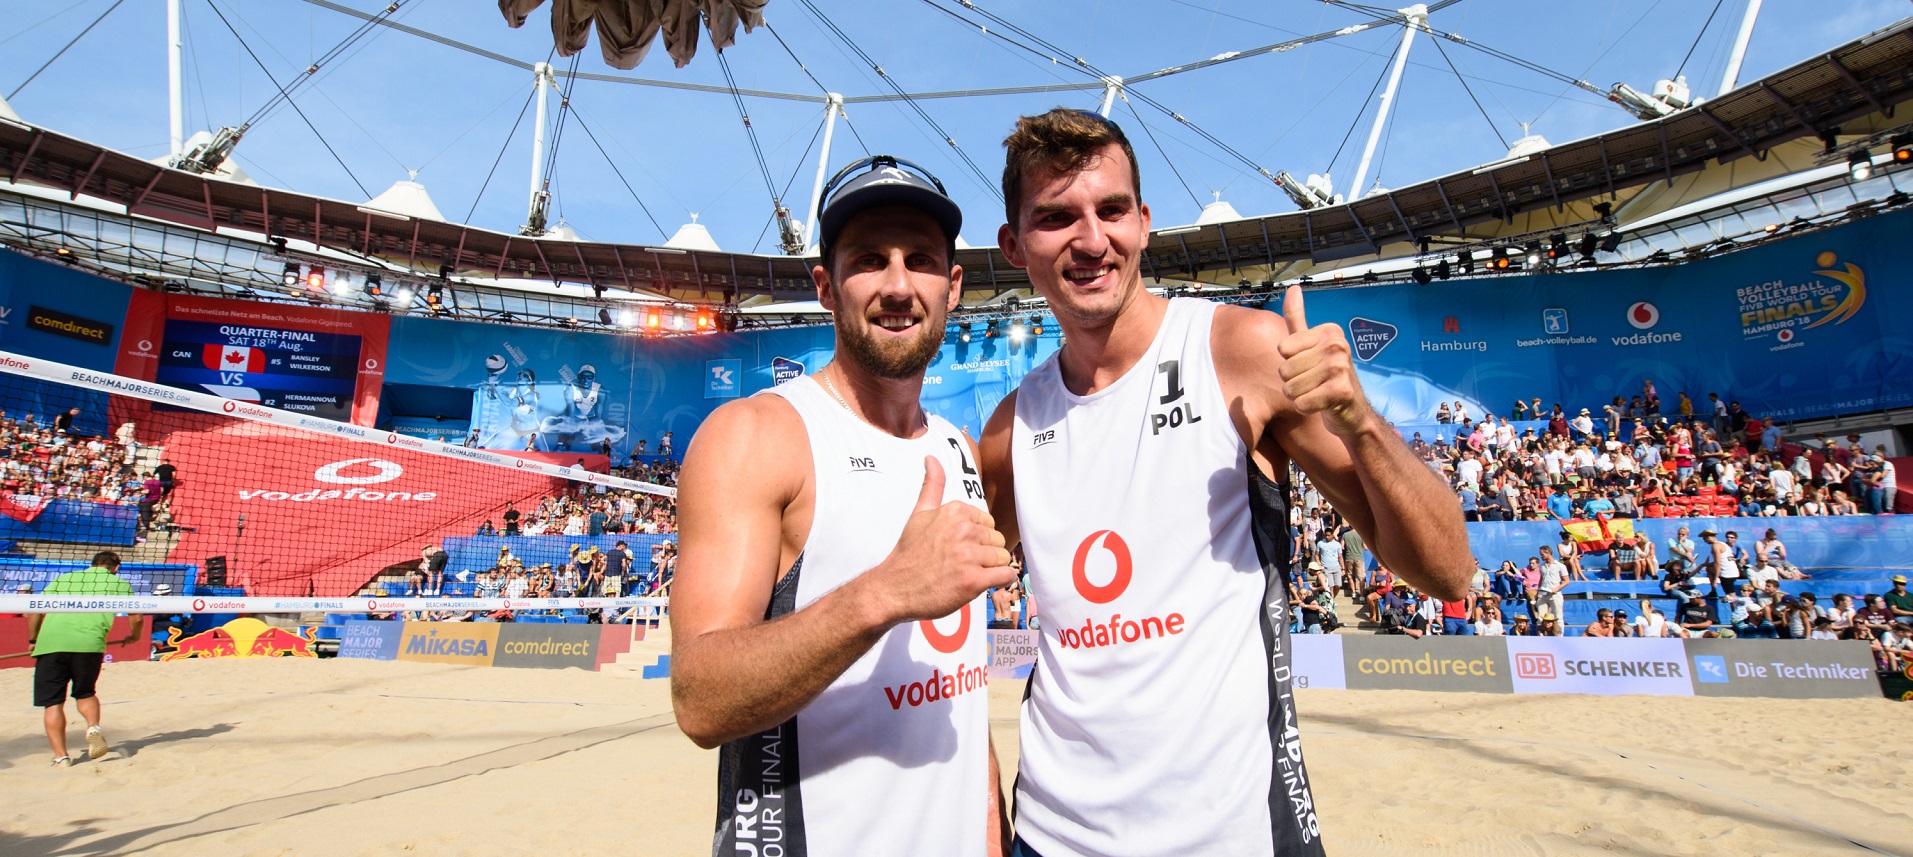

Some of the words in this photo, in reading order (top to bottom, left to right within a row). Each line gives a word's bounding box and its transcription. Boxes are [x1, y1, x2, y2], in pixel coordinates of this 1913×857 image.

[1736, 279, 1783, 298] BEACH
[1738, 280, 1824, 305] VOLLEYBALL
[1739, 301, 1764, 312] FIVB
[1767, 292, 1808, 307] WORLD
[1811, 285, 1842, 297] TOUR
[175, 305, 189, 313] Das
[191, 307, 229, 317] schnellste
[230, 310, 247, 318] Netz
[286, 315, 318, 324] Vodafone
[1741, 294, 1838, 327] FINALS
[34, 315, 104, 339] comdirect
[219, 325, 316, 342] QUARTER-FINAL
[1743, 319, 1795, 335] HAMBURG
[228, 336, 249, 346] SAT
[278, 340, 304, 352] Aug.
[1357, 332, 1389, 342] ACTIVE
[1516, 335, 1597, 348] beach-volleyball.de
[1611, 331, 1682, 346] vodafone
[1358, 342, 1379, 351] CITY
[1421, 340, 1487, 351] Hamburg
[1769, 341, 1805, 352] vodafone
[128, 350, 158, 359] vodafone
[172, 350, 192, 358] CAN
[270, 358, 282, 366] #5
[290, 354, 320, 363] BANSLEY
[289, 363, 331, 372] WILKERSON
[950, 361, 978, 371] GRAND
[967, 366, 994, 374] HAMBURG
[220, 371, 244, 386] VS
[776, 370, 799, 379] ACTIVE
[1158, 359, 1185, 405] 1
[264, 398, 276, 406] #2
[283, 403, 316, 411] SLUKOVA
[1151, 402, 1202, 436] POL
[238, 406, 273, 419] vodafone
[398, 438, 424, 448] vodafone
[524, 463, 543, 471] vodafone
[1033, 430, 1055, 446] FIVB
[849, 456, 876, 469] FIVB
[947, 437, 977, 475] 2
[238, 487, 437, 502] vodafone
[962, 479, 986, 499] PO
[29, 600, 158, 609] BEACHMAJORSERIES.COM
[208, 601, 246, 609] vodafone
[346, 624, 381, 637] BEACH
[1056, 612, 1185, 650] vodafone
[344, 637, 383, 649] MAJOR
[504, 637, 589, 656] comdirect
[996, 634, 1030, 645] BEACH
[995, 646, 1039, 656] MAJORS
[995, 657, 1016, 667] APP
[1358, 652, 1496, 677] comdirect
[1520, 656, 1552, 675] DB
[1563, 659, 1683, 678] SCHENKER
[1734, 661, 1767, 678] Die
[1771, 662, 1869, 680] Techniker
[883, 663, 989, 711] vodafone
[1277, 756, 1312, 845] FINALS
